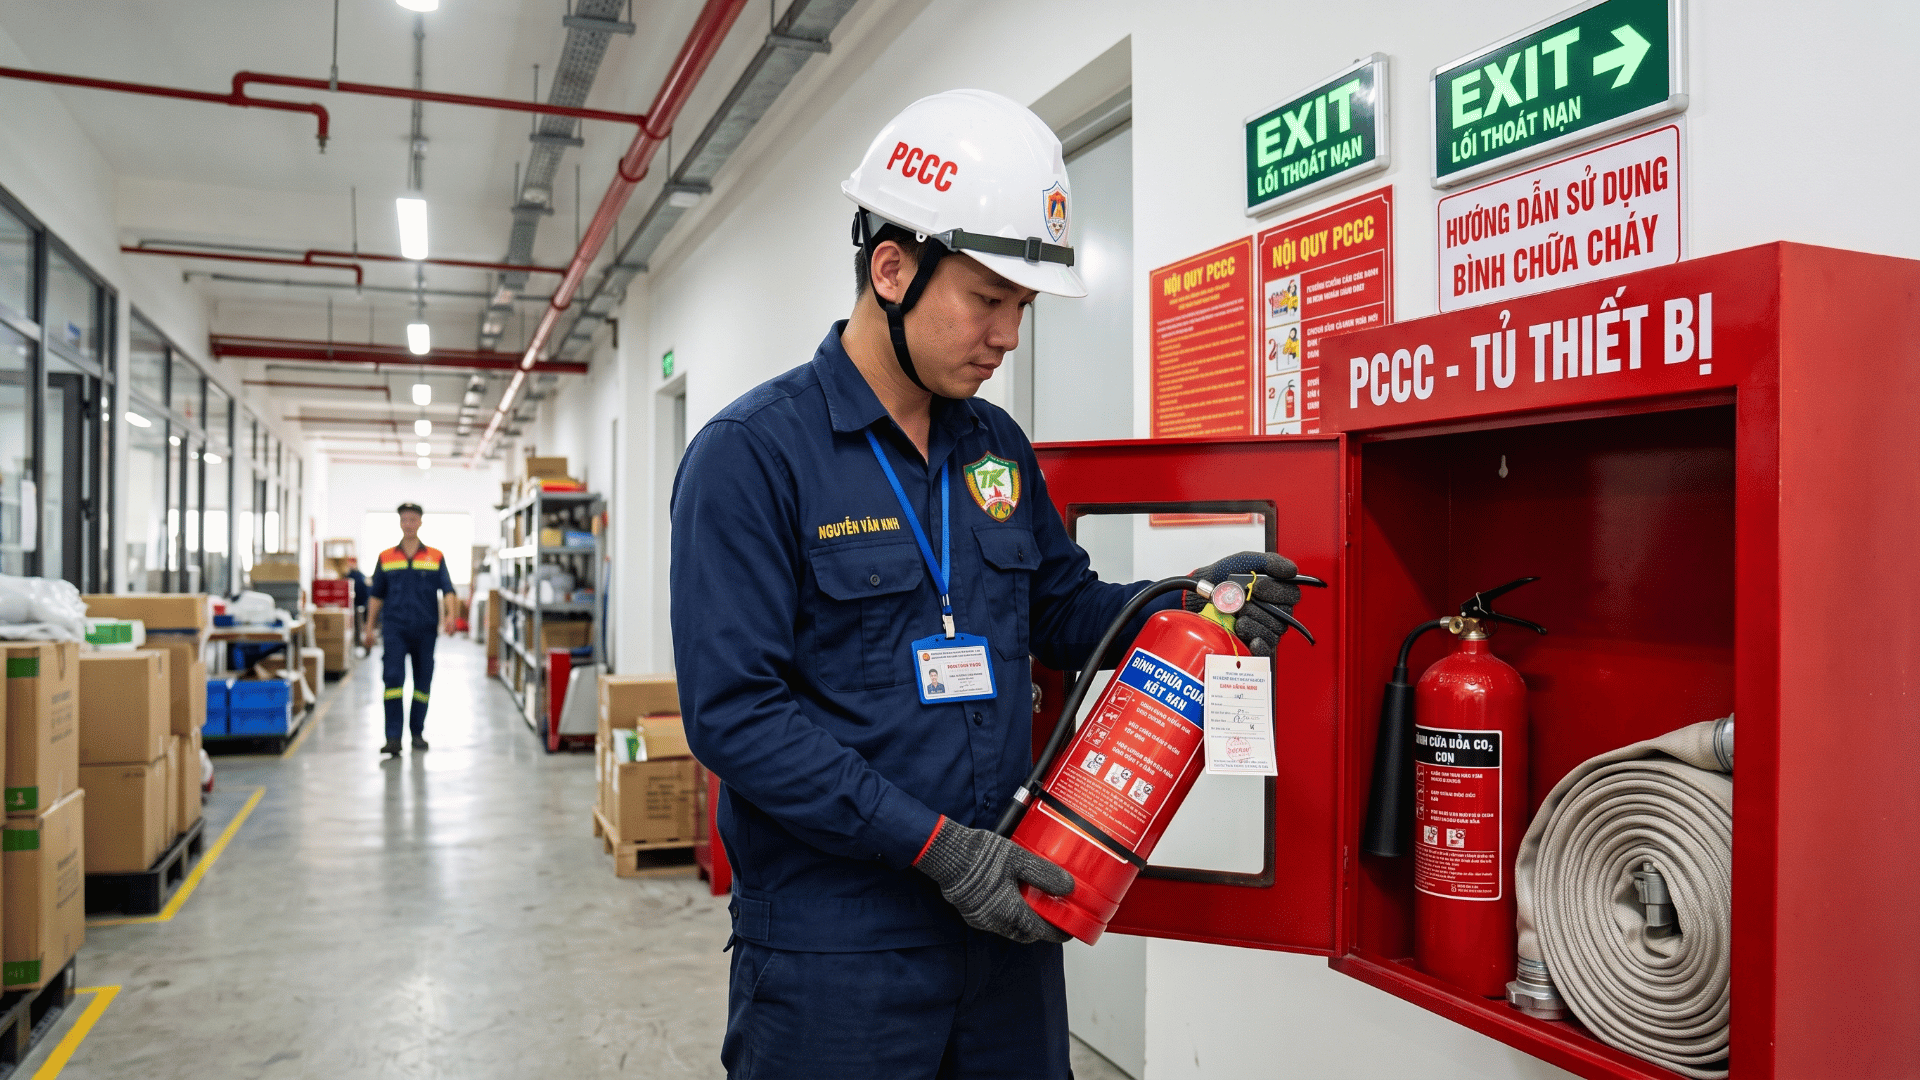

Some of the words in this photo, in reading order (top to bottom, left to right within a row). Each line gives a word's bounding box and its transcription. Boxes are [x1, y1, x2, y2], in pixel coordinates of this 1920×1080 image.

[1452, 26, 1580, 129] EXIT
[1257, 78, 1360, 168] EXIT
[1452, 128, 1477, 163] LỐI
[1481, 110, 1538, 151] THOÁT
[1543, 95, 1580, 132] NẠN
[887, 142, 958, 193] PCCC
[1257, 165, 1279, 197] LỐI
[1281, 149, 1327, 186] THOÁT
[1330, 135, 1362, 168] NẠN
[1446, 204, 1510, 249] HƯỚNG
[1517, 180, 1559, 230] DẪN
[1567, 164, 1597, 215] SỬ
[1603, 156, 1668, 208] DỤNG
[1163, 272, 1181, 297] NỘI
[1184, 268, 1203, 291] QUY
[1206, 256, 1236, 282] PCCC
[1272, 238, 1297, 270] NỘI
[1300, 230, 1329, 262] QUY
[1333, 215, 1375, 250] PCCC
[1453, 253, 1505, 297] BÌNH
[1513, 231, 1578, 283] CHỮA
[1587, 211, 1659, 267] CHÁY
[1350, 344, 1434, 409] PCCC
[1471, 309, 1516, 391] TỦ
[1528, 286, 1649, 383] THIẾT
[1664, 292, 1713, 376] BỊ
